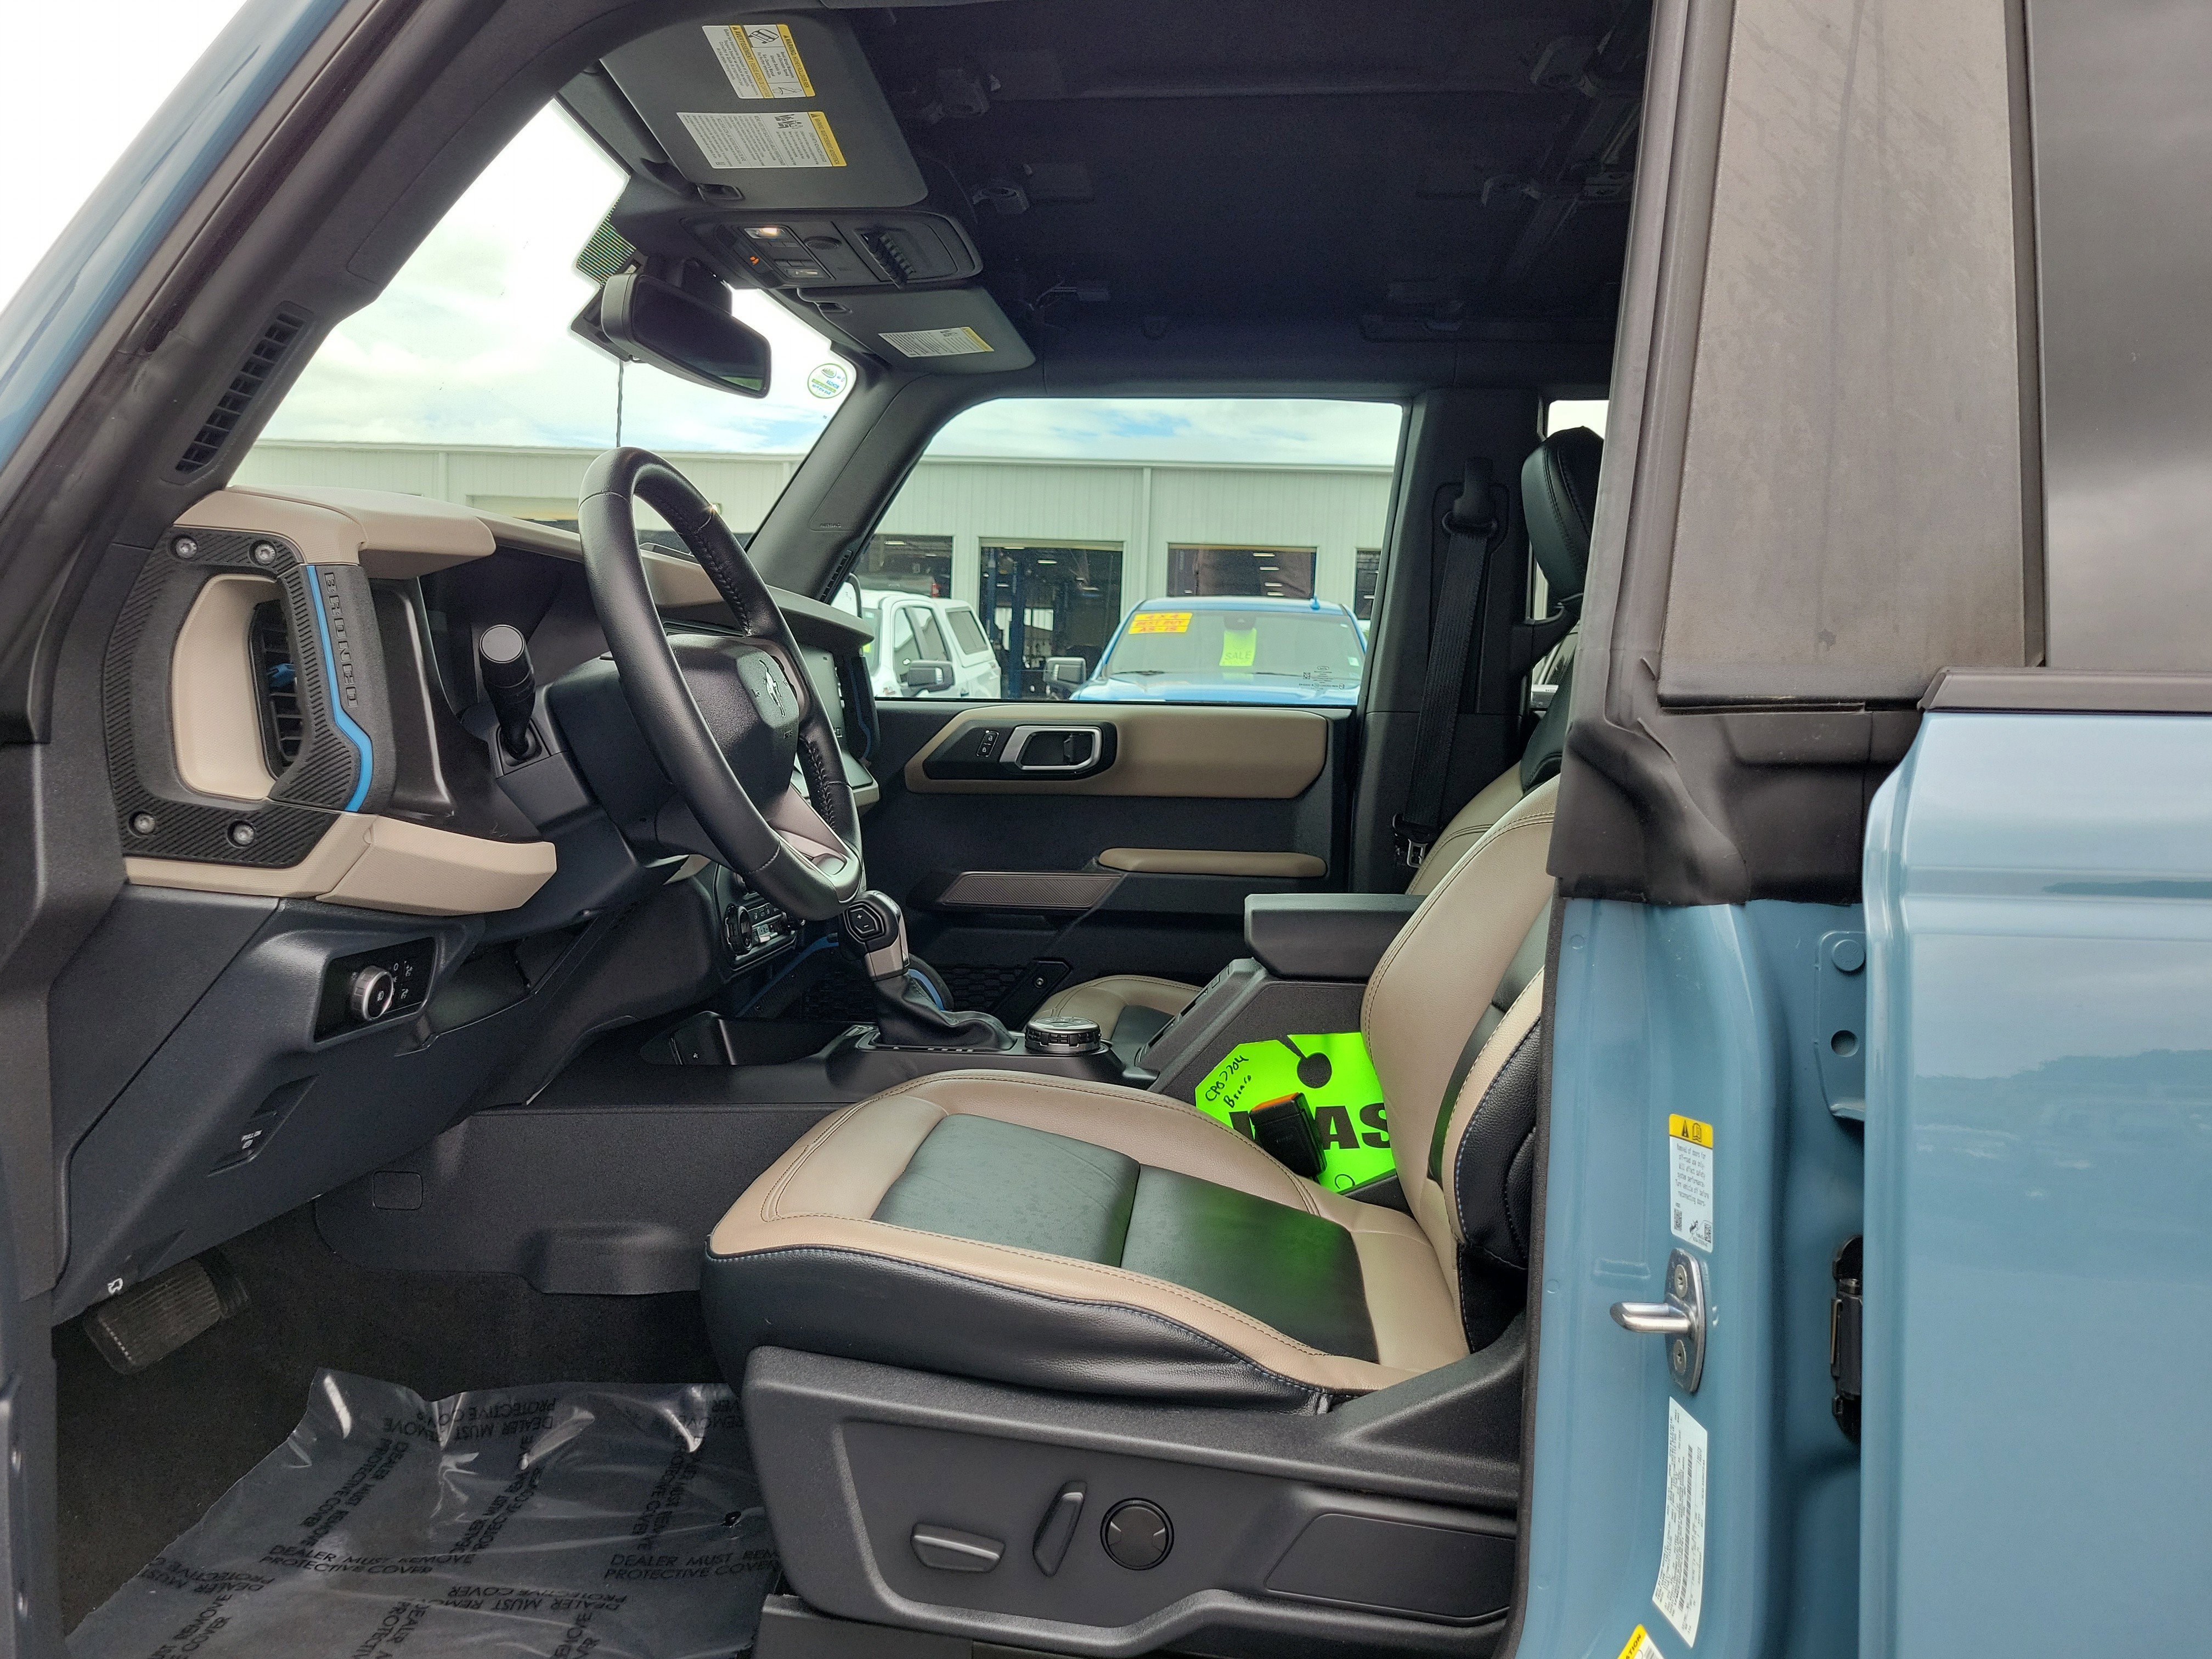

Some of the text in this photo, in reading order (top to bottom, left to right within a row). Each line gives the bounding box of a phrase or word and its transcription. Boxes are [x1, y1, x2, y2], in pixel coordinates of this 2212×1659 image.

[324, 572, 358, 708] BRONCO
[1224, 651, 1252, 660] SALE
[455, 1422, 493, 1441] MUST
[269, 1544, 476, 1566] DEALER MUST REMOVE
[610, 1553, 679, 1566] DEALER
[686, 1551, 734, 1566] MUST
[259, 1555, 433, 1575] PROTECTIVE COVER
[604, 1567, 713, 1581] PROTECTIVE
[193, 1582, 264, 1595] DEALER
[447, 1585, 516, 1597] COVER
[490, 1597, 543, 1611] MUST
[550, 1597, 621, 1611] DEALER
[172, 1593, 234, 1640] REMOVE
[181, 1616, 234, 1652] COVER
